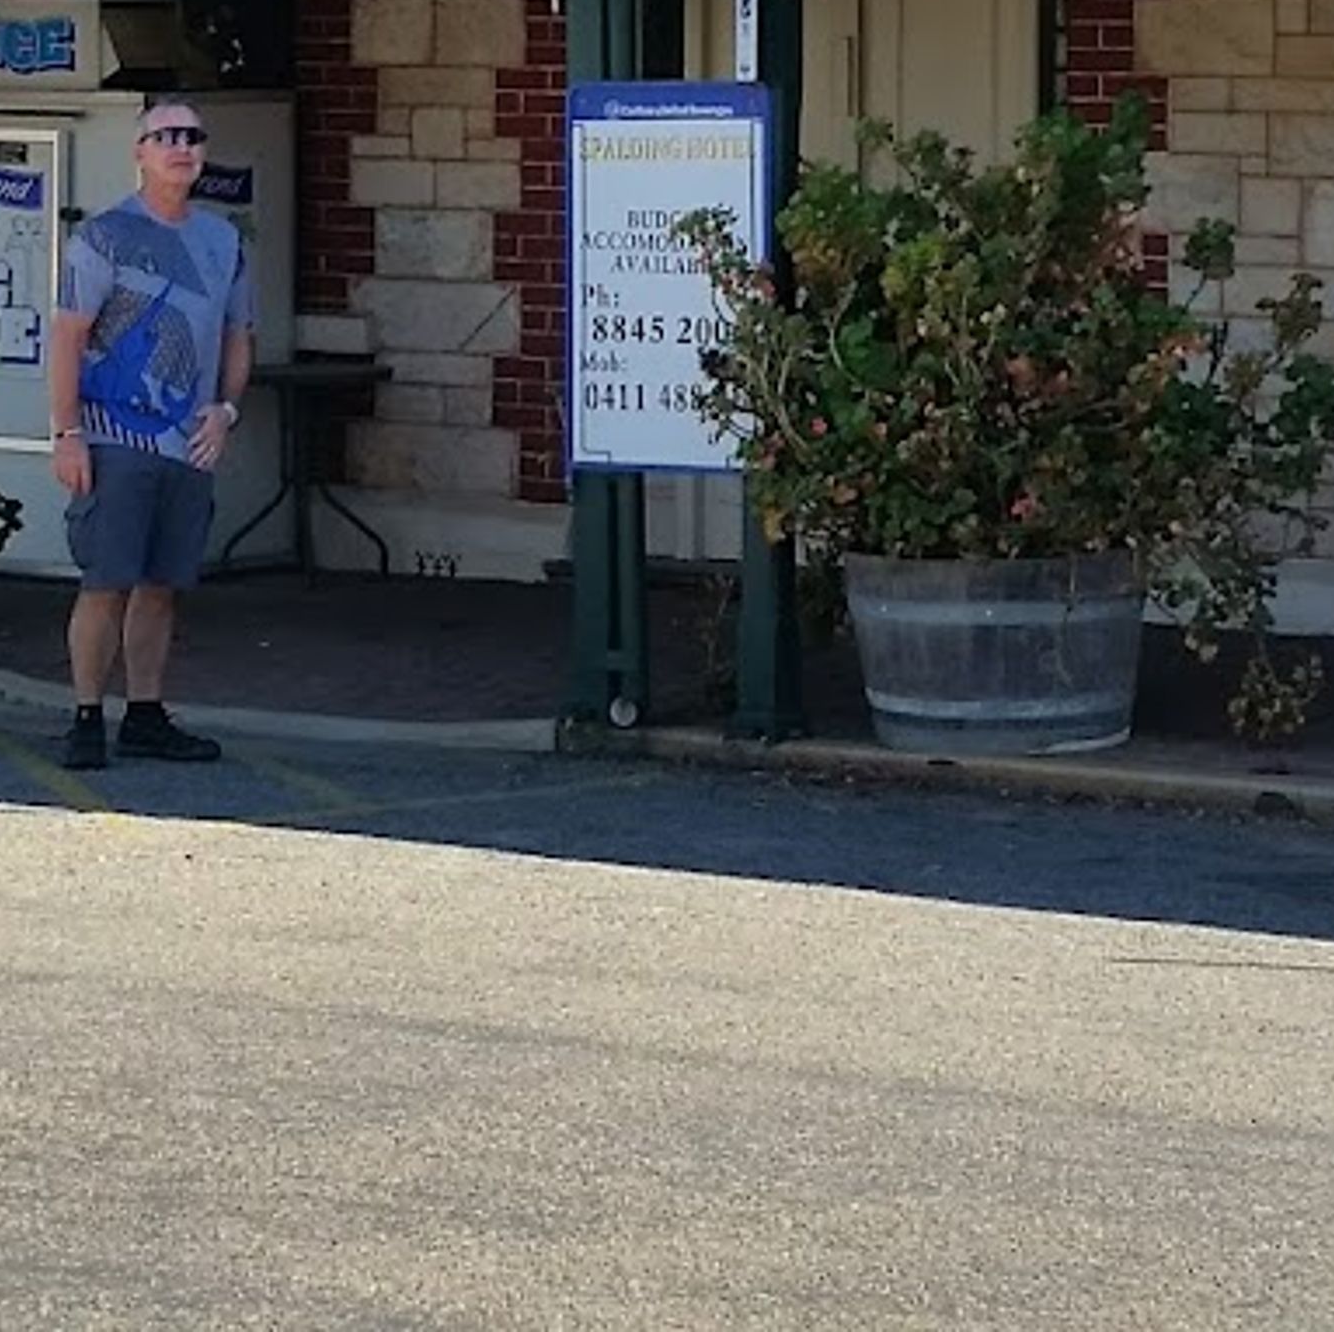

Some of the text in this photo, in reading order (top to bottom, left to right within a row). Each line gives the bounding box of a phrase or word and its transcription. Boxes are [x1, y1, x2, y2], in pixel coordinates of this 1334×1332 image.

[581, 284, 619, 308] Ph:
[591, 314, 730, 346] 8845 200
[585, 382, 644, 412] 0411
